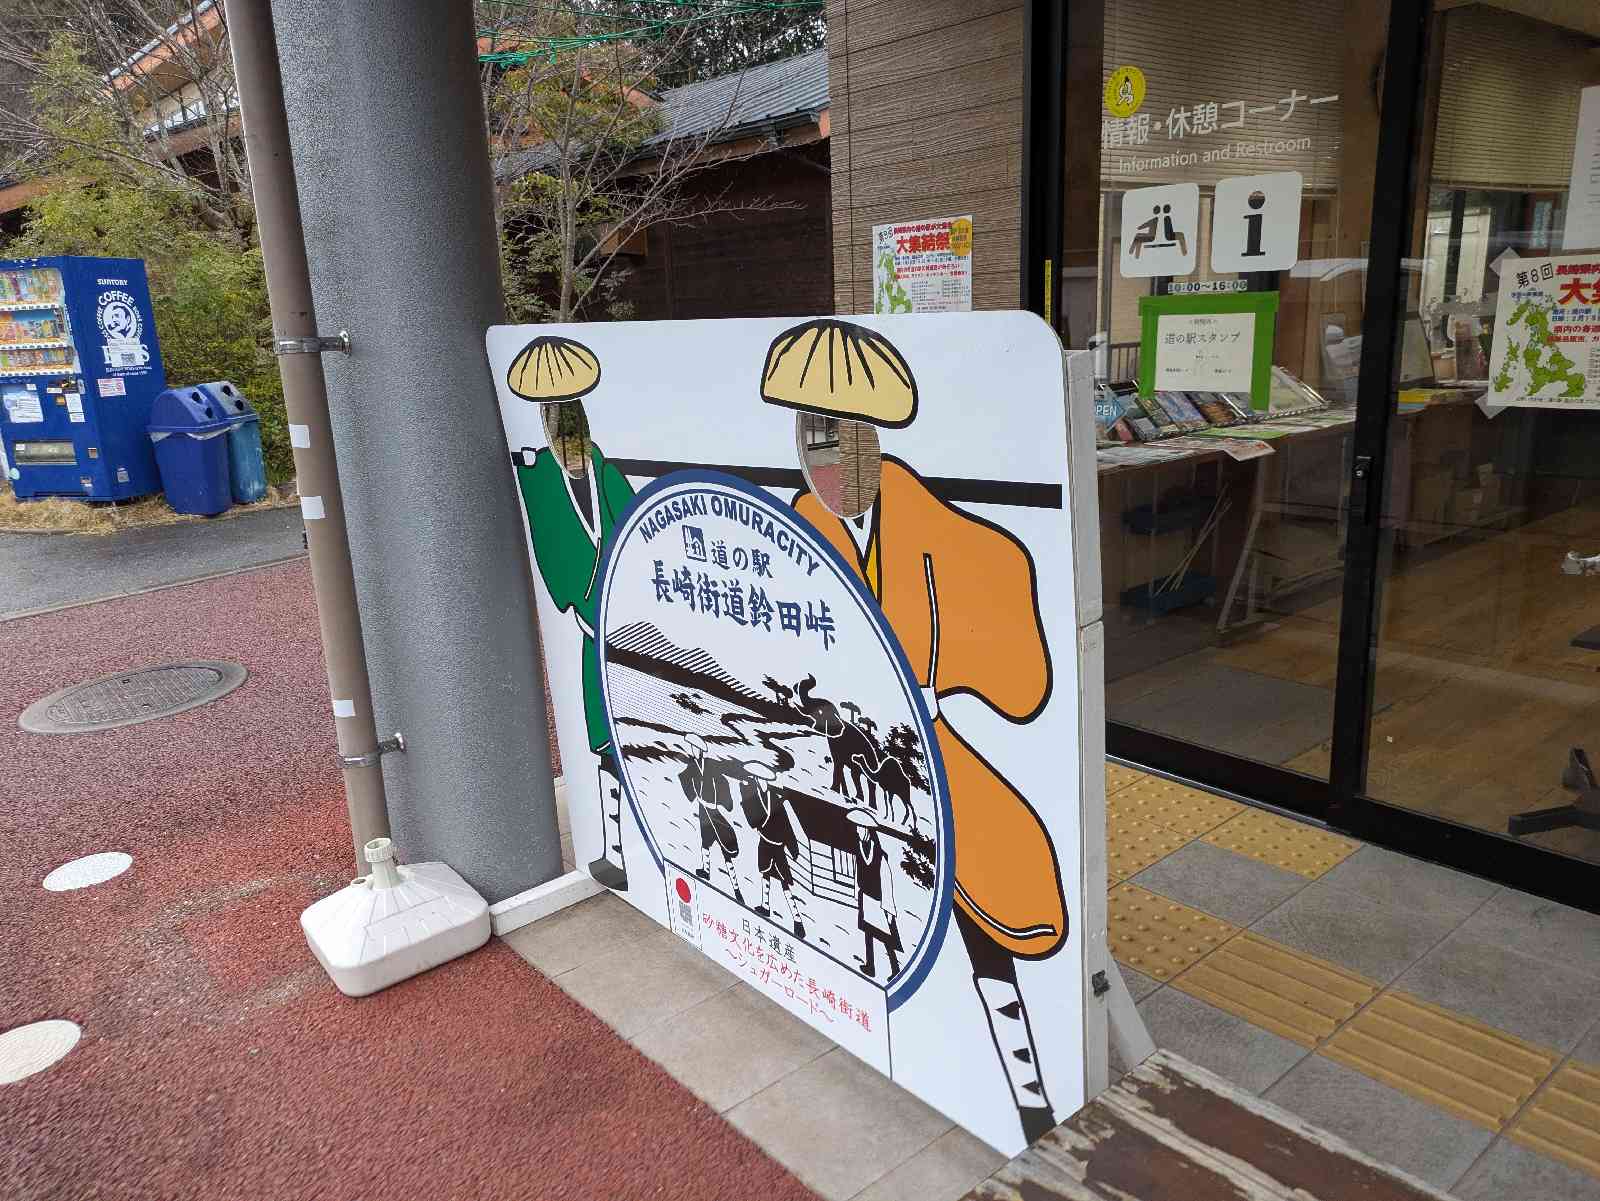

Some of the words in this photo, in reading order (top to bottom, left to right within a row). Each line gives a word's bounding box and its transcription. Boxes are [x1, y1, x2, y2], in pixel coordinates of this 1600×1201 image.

[1101, 88, 1340, 149] 情報・休憩コーナー
[1118, 149, 1198, 174] Information
[1202, 144, 1231, 162] and
[1234, 136, 1312, 158] Restroom
[96, 278, 128, 286] SUNTORY
[1516, 263, 1554, 288] 第8回
[98, 290, 135, 307] COFFEE
[1164, 331, 1241, 345] 道の駅スタンプ
[1096, 404, 1118, 417] PEN
[638, 495, 708, 544] NAGASAKI
[710, 496, 821, 577] OMURACITY
[710, 539, 774, 579] 道の駅
[651, 559, 836, 651] 長崎街道鈴田峠
[742, 918, 798, 964] 日本遺産
[702, 913, 873, 1032] 砂糖文化を広めた長崎街道
